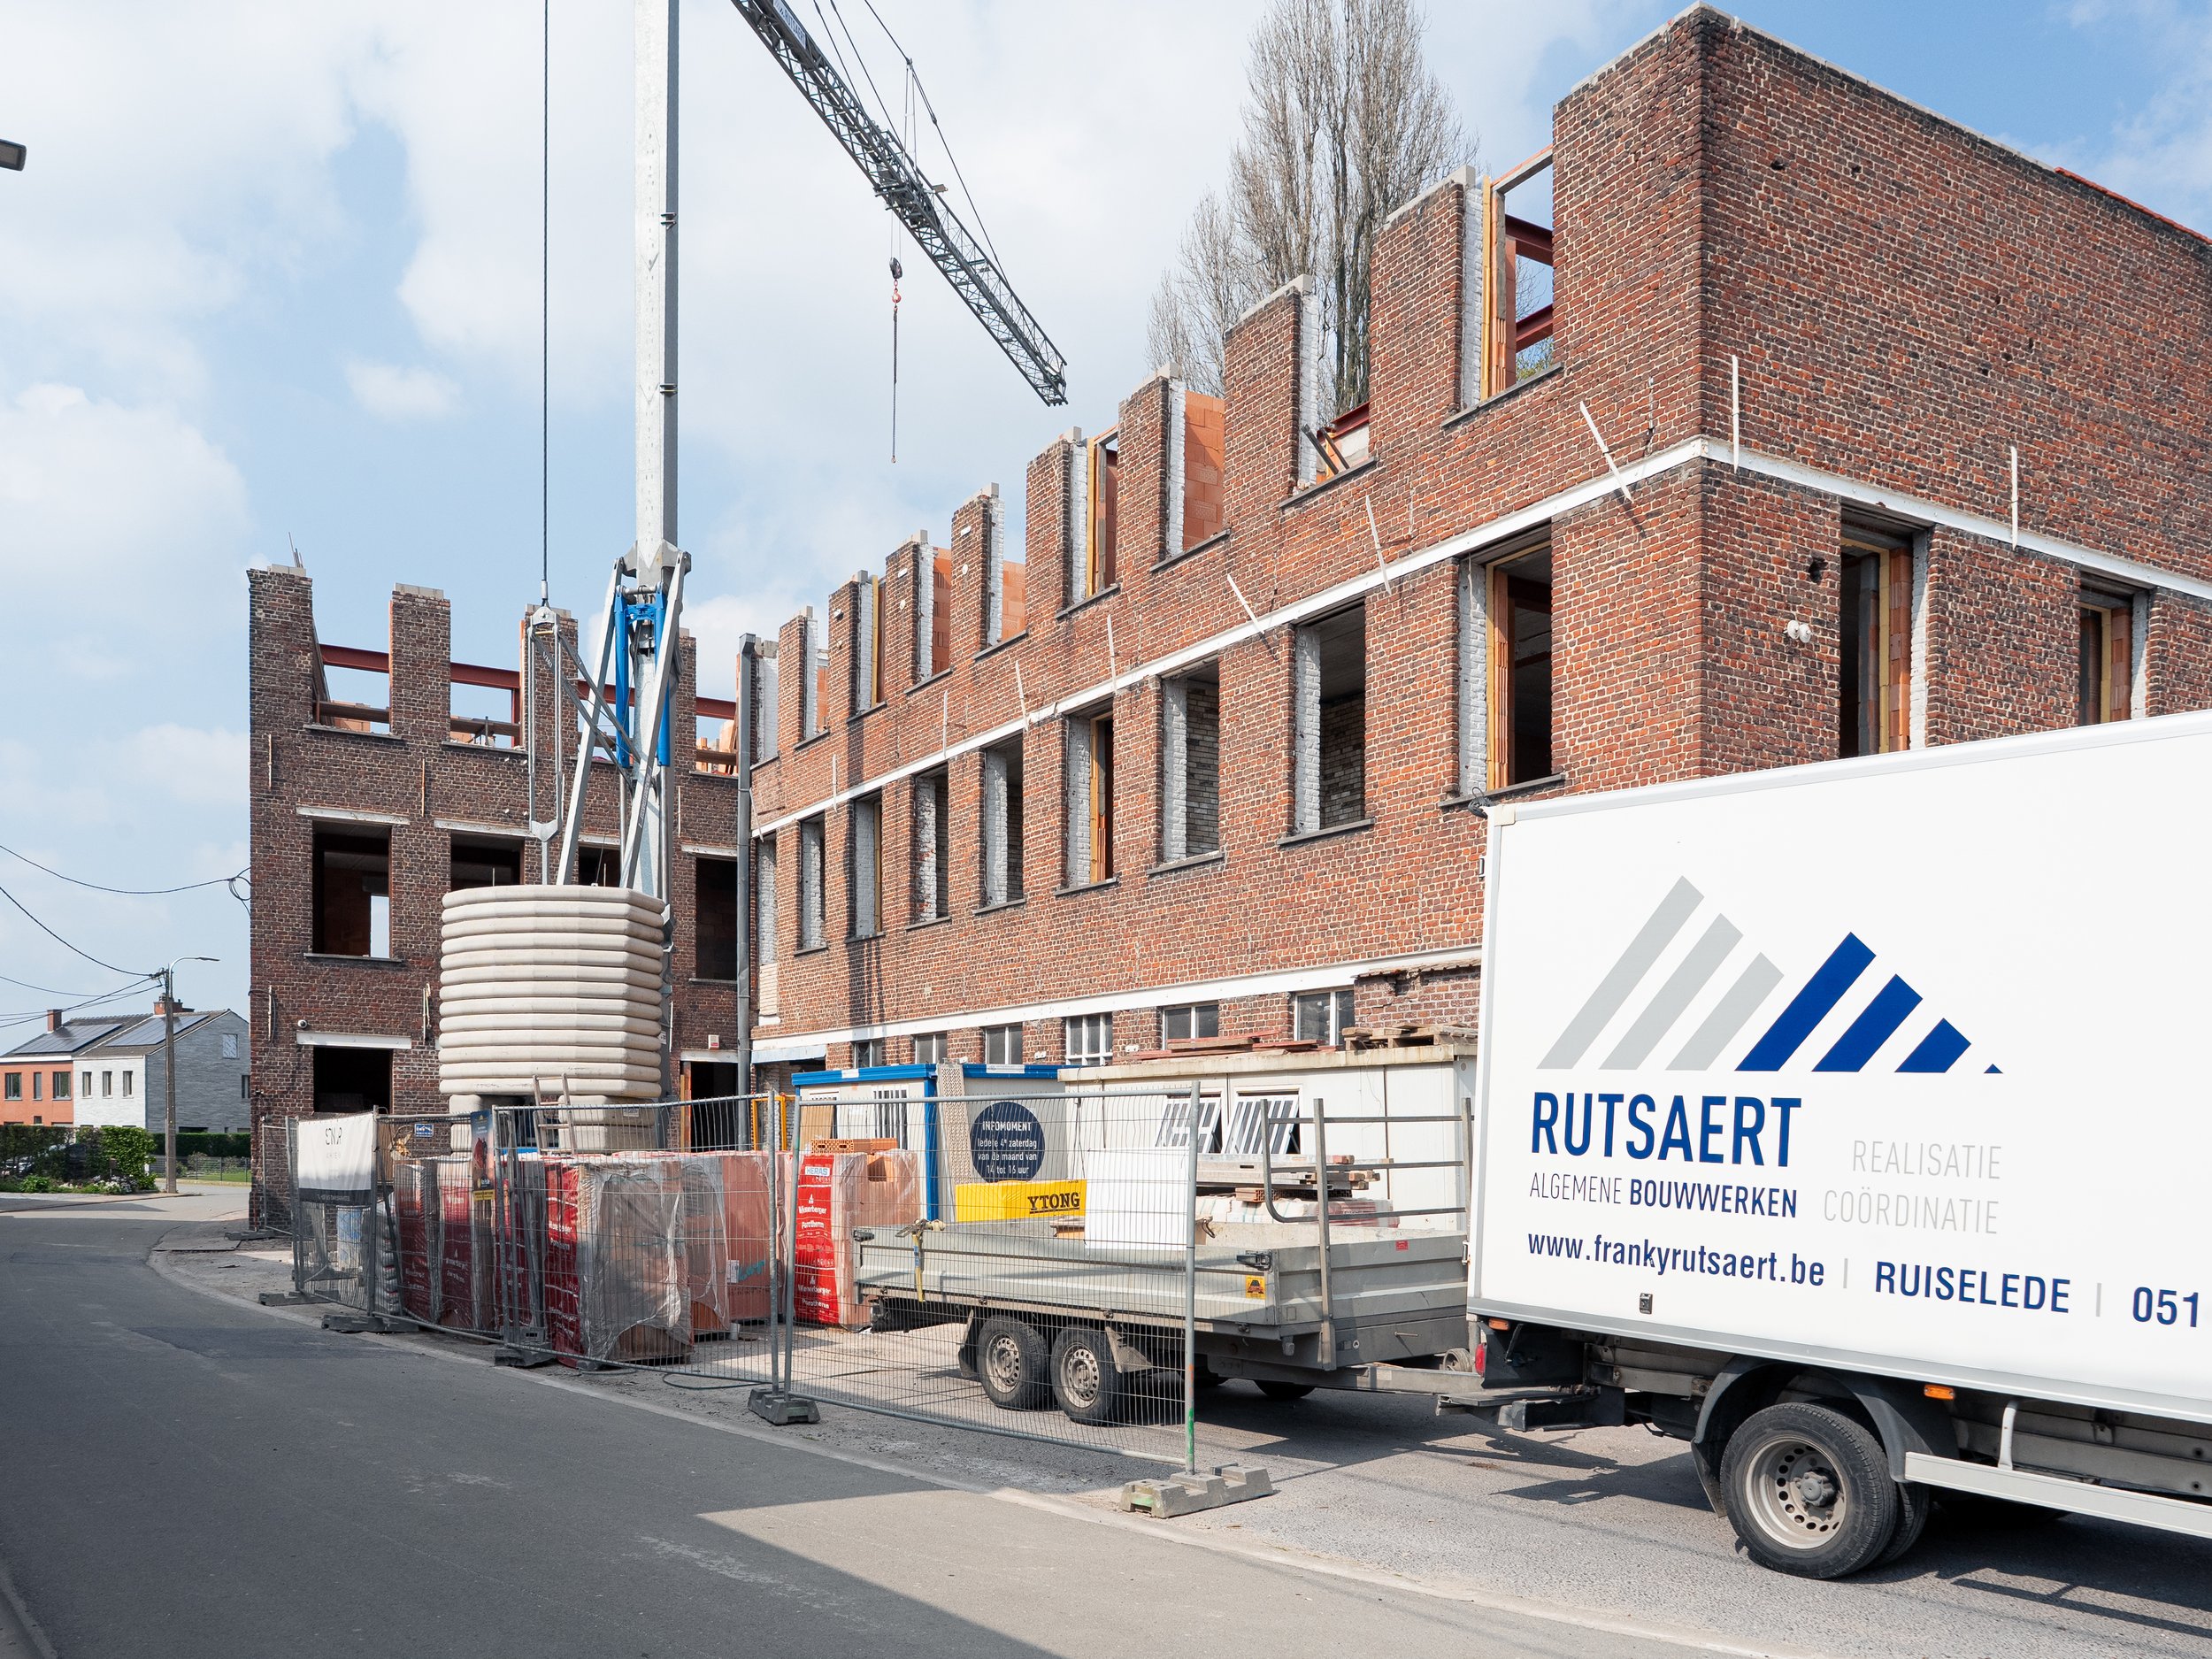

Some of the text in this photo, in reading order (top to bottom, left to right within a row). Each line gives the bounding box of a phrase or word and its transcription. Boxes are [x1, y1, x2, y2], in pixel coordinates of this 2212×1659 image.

[982, 1121, 1032, 1132] INFOMOMENT
[1532, 1092, 1801, 1167] RUTSAERT
[978, 1139, 998, 1148] Iedere
[1009, 1139, 1037, 1149] zaterdag
[992, 1152, 1000, 1161] de
[1002, 1152, 1024, 1161] maand
[987, 1165, 995, 1174] 14
[1853, 1141, 2001, 1179] REALISATIE
[1028, 1192, 1080, 1210] YTONG
[1530, 1172, 1797, 1217] ALGEMENE BOUWWERKEN
[1824, 1187, 1998, 1233] COÖRDINATIE
[1528, 1233, 2199, 1327] www.frankyrutsaert.be RUISELEDE 051
